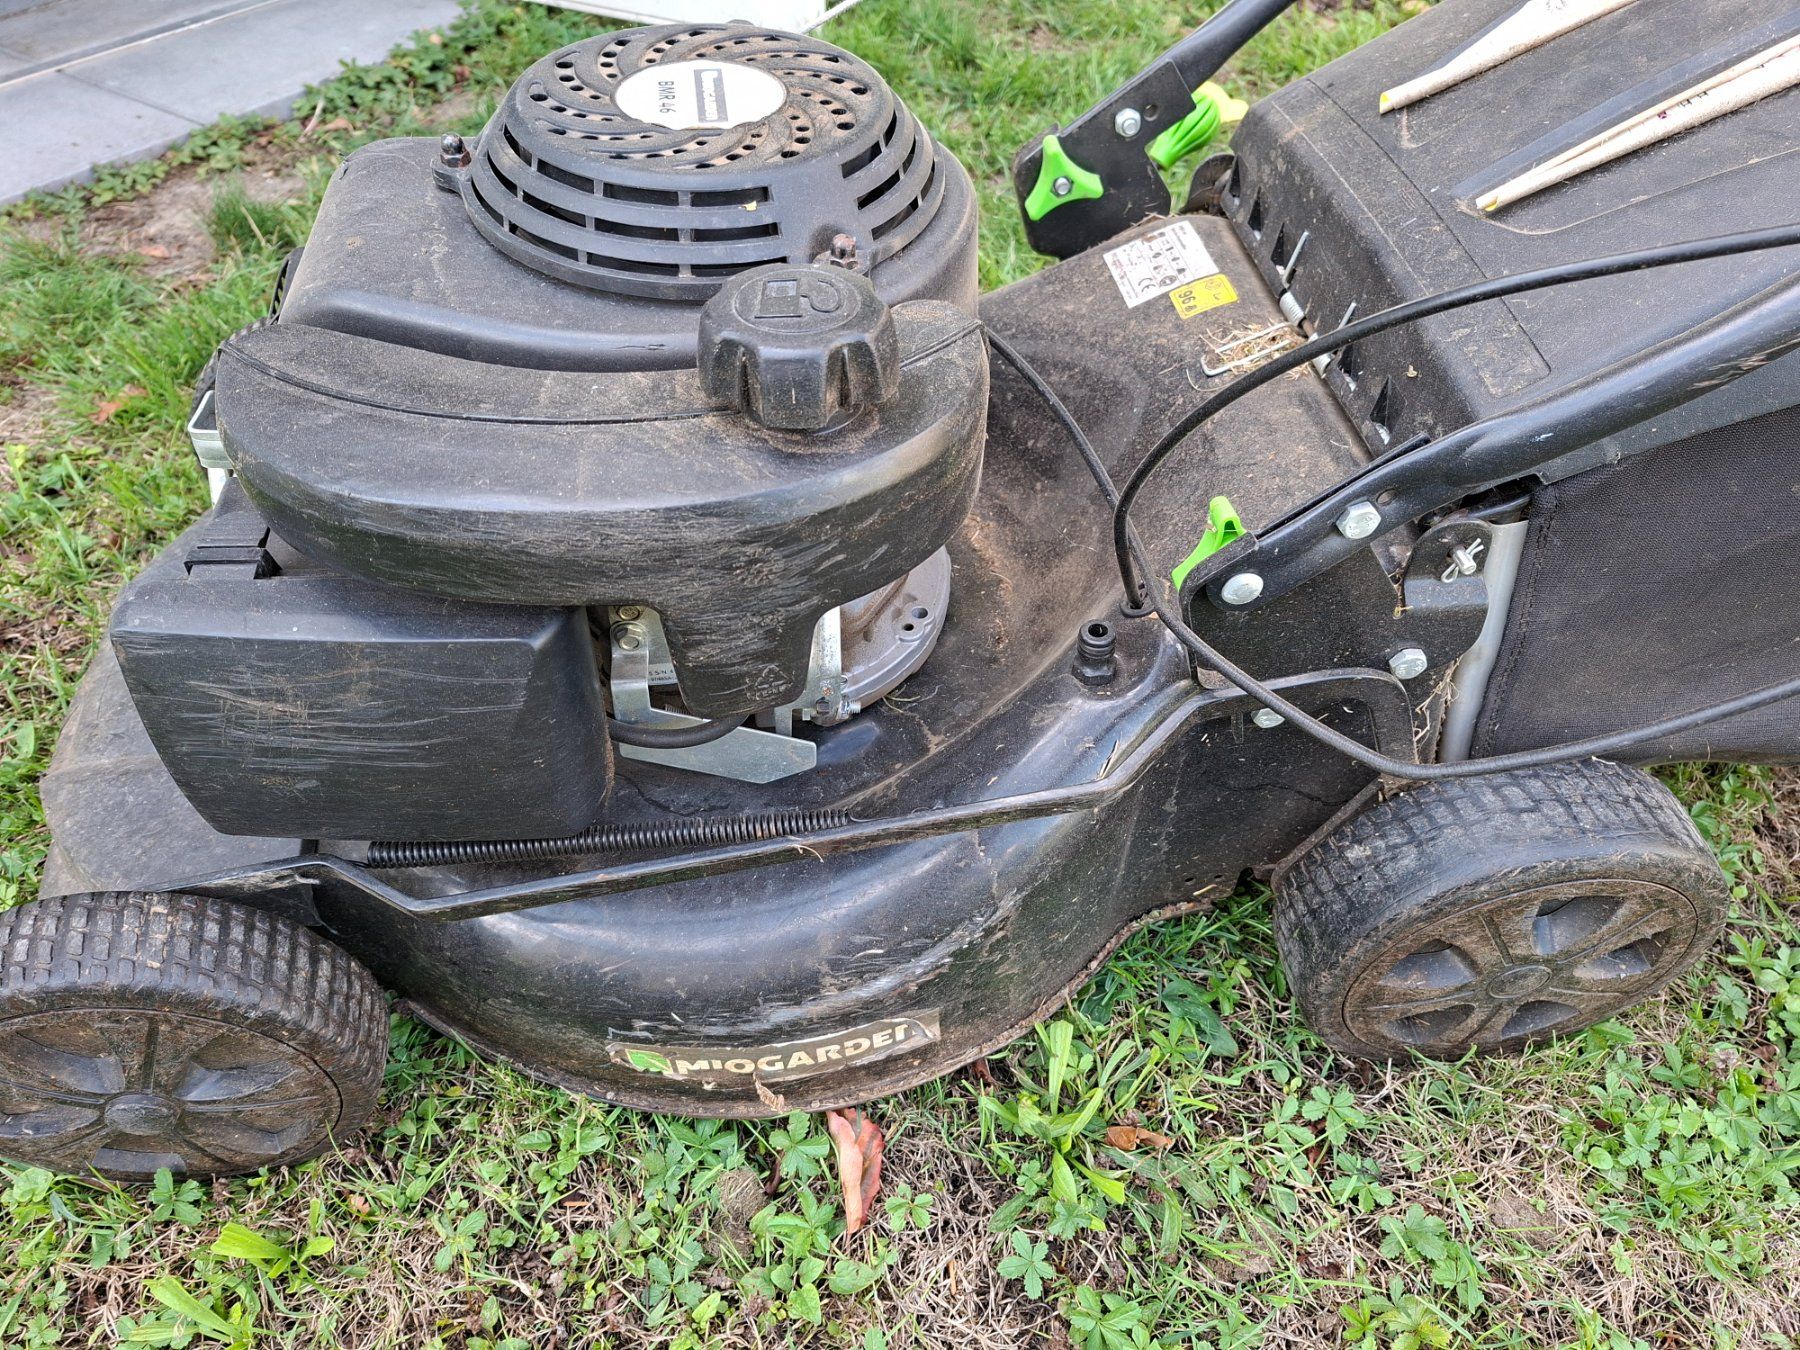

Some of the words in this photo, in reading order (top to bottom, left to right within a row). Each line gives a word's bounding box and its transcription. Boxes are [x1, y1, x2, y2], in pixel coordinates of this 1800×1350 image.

[658, 81, 675, 100] BMR
[659, 102, 676, 113] 46
[1138, 278, 1156, 292] CE
[1178, 290, 1196, 304] 96
